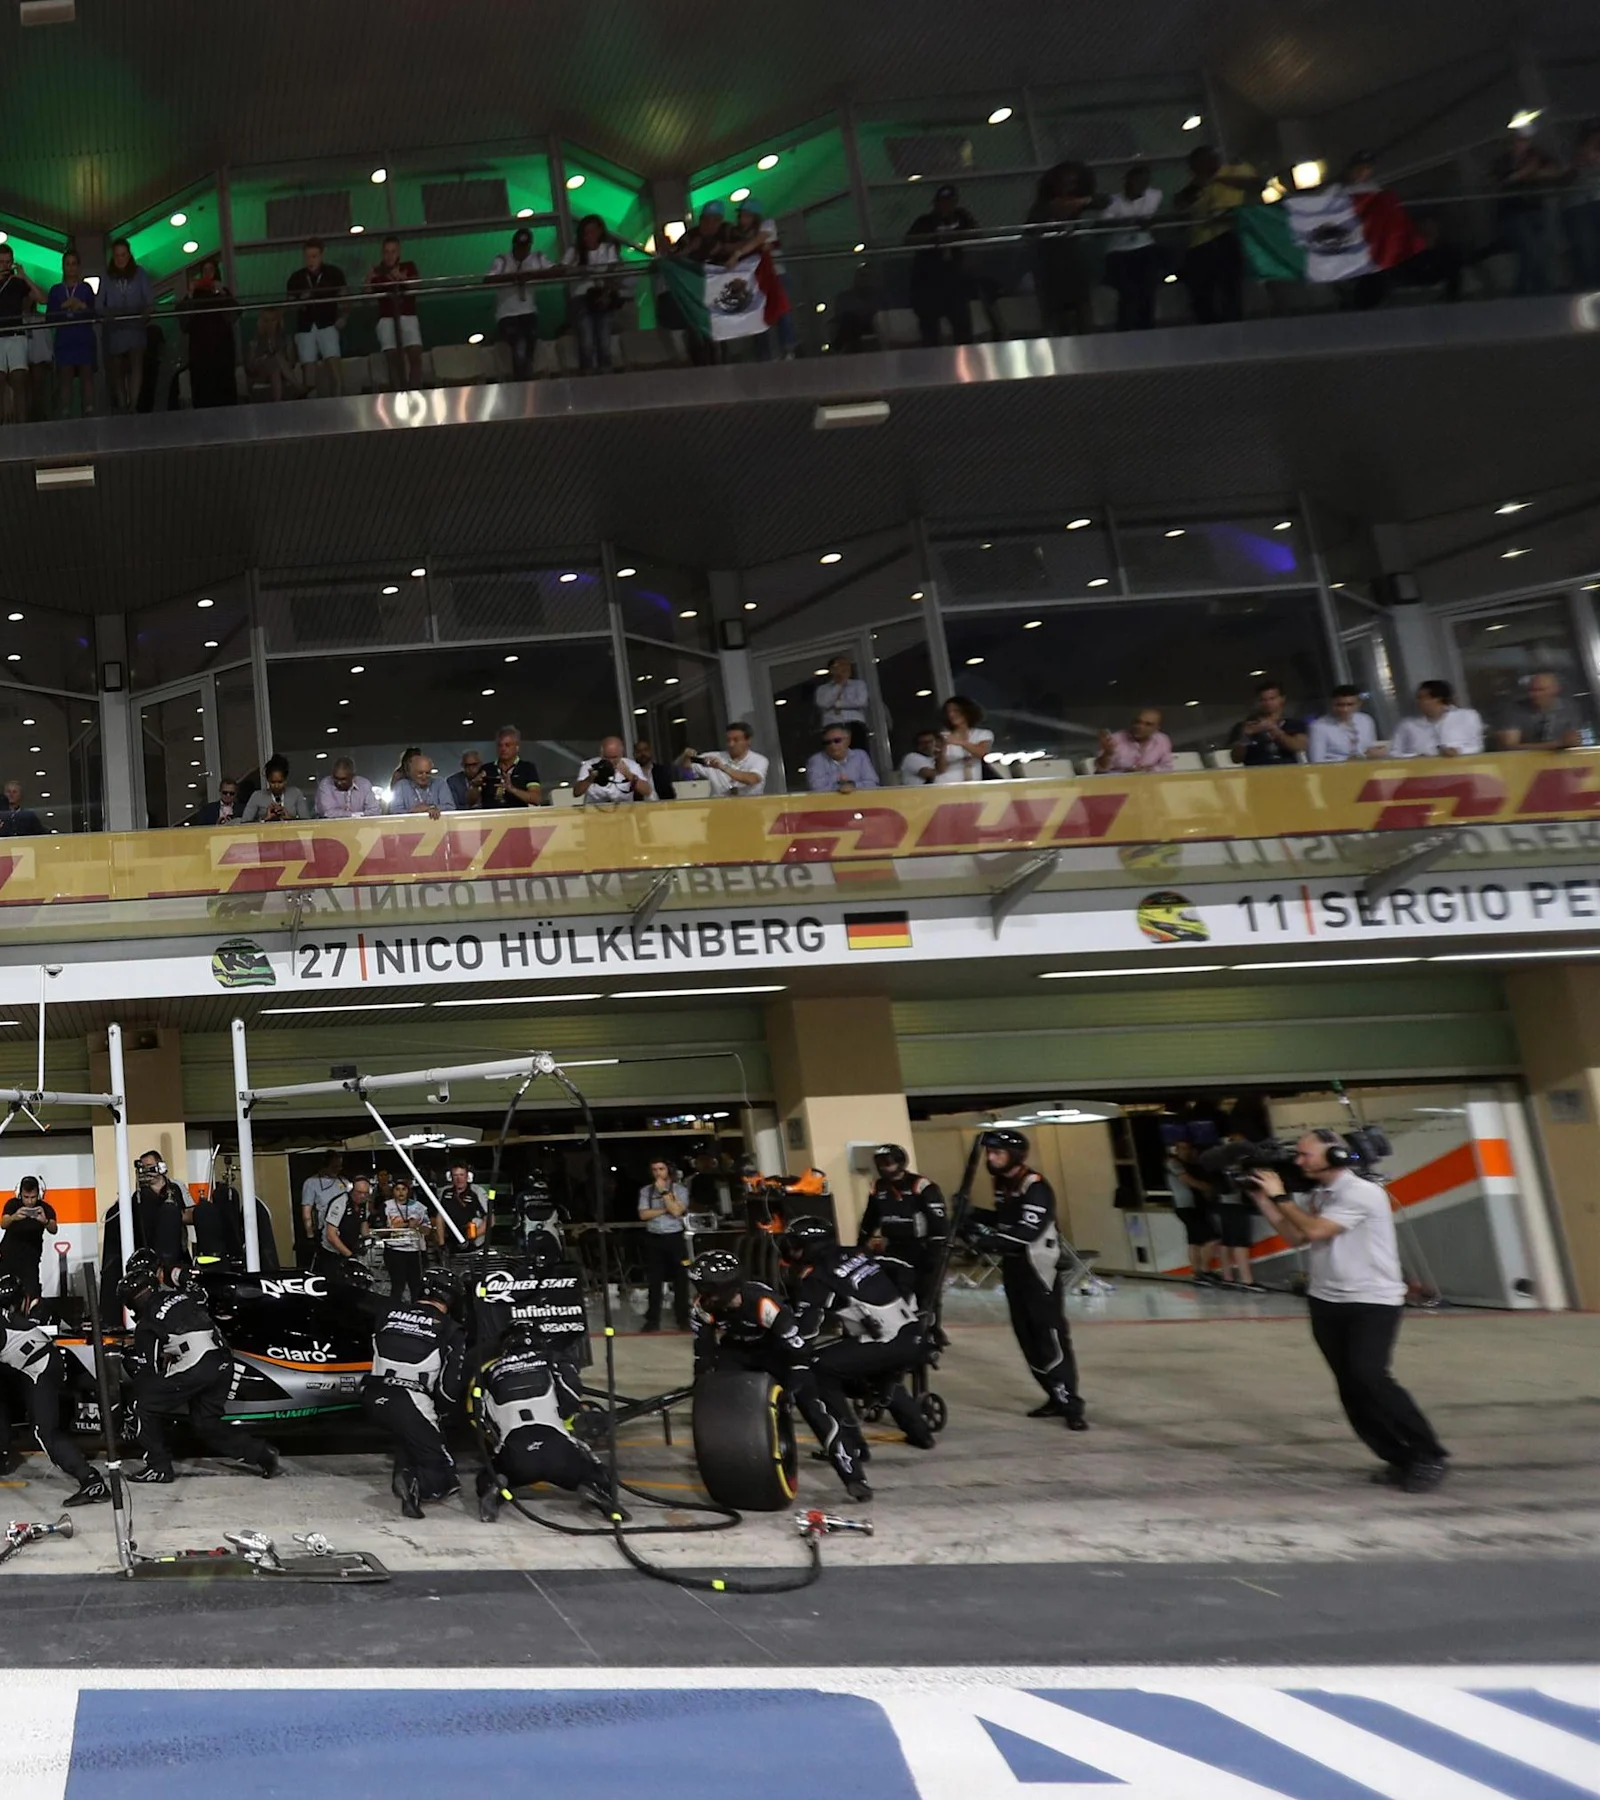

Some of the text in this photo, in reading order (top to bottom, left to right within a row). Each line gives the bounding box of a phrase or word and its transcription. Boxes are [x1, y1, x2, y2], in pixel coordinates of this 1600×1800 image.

[1356, 767, 1600, 830] DH
[769, 794, 1159, 863] DHL
[217, 825, 582, 894] DHL
[1238, 879, 1600, 932] 11 SERGIO PE
[300, 916, 826, 979] 27 NICO HÜLKENBERG
[260, 1276, 328, 1299] NEC
[486, 1277, 578, 1292] QUAKER STATE
[387, 1310, 433, 1327] SAHARA
[510, 1304, 583, 1318] infinitum
[267, 1346, 328, 1363] Claro
